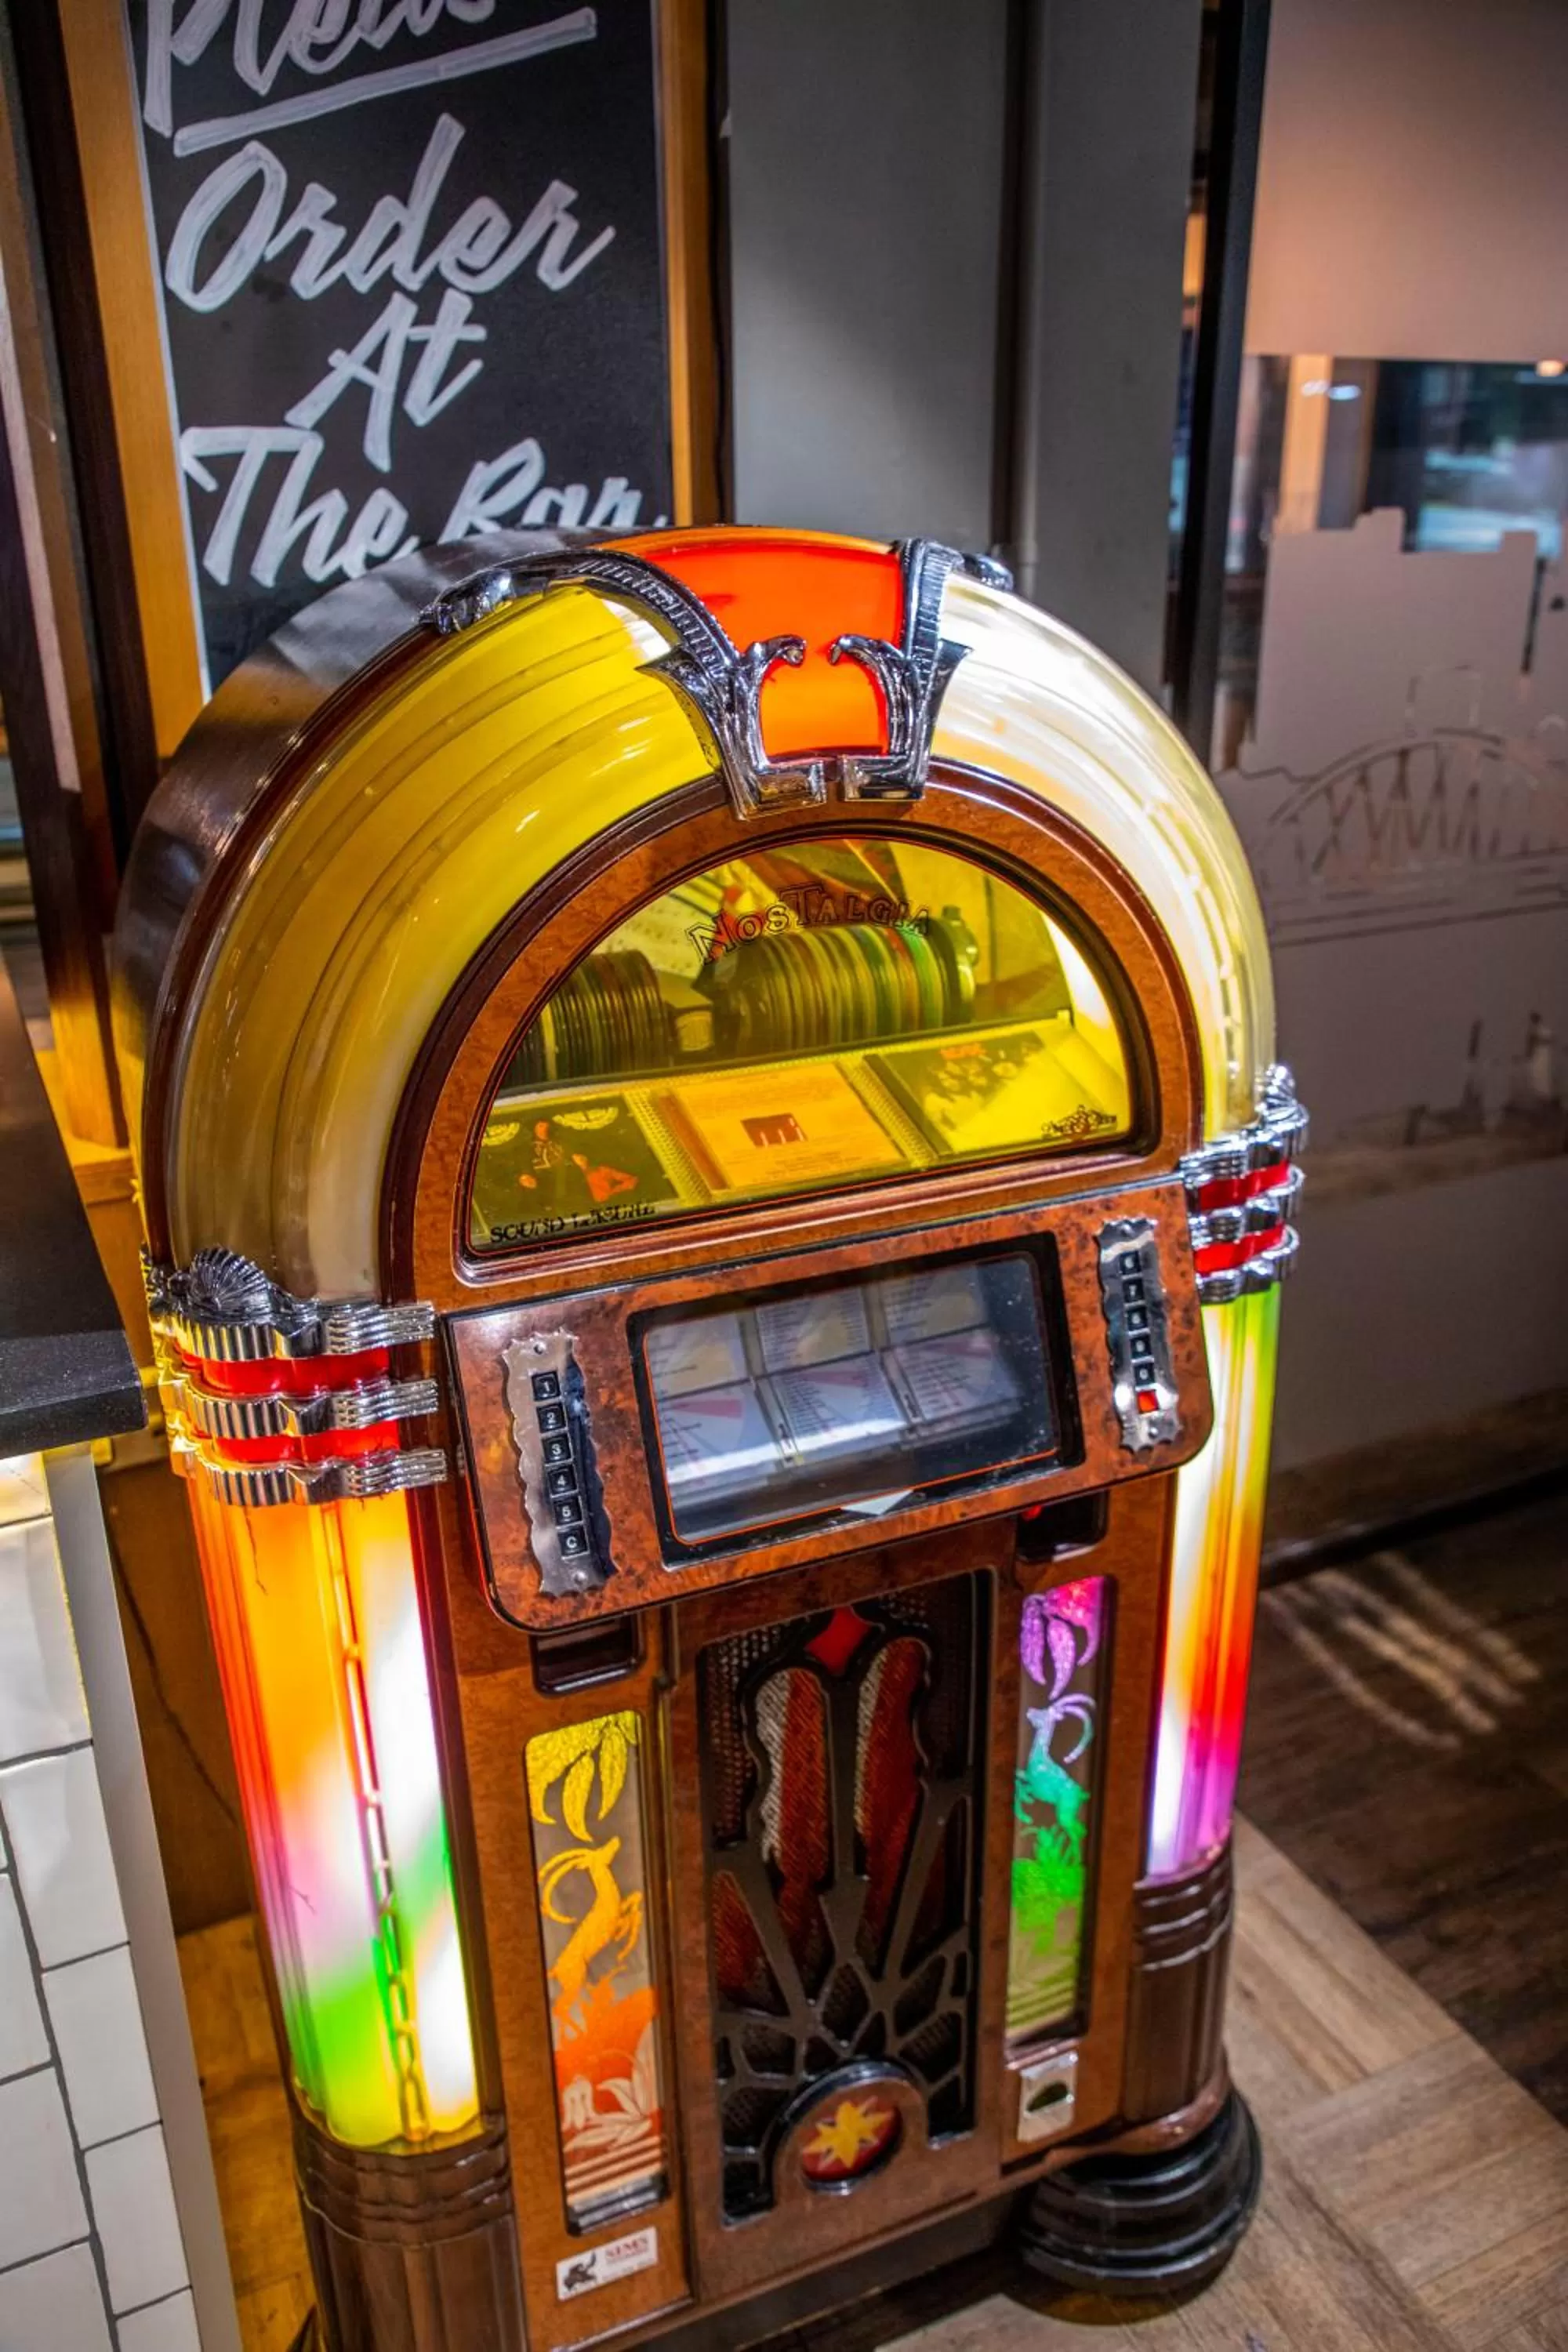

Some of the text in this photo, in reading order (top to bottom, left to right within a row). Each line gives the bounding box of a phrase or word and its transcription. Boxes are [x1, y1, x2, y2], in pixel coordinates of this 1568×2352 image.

[165, 113, 615, 312] Order
[284, 291, 487, 472] At
[180, 426, 419, 587] The
[490, 1217, 565, 1243] SOUND
[546, 1413, 555, 1425] 2
[551, 1443, 561, 1455] 3
[557, 1475, 566, 1487] 4
[565, 1535, 578, 1549] C
